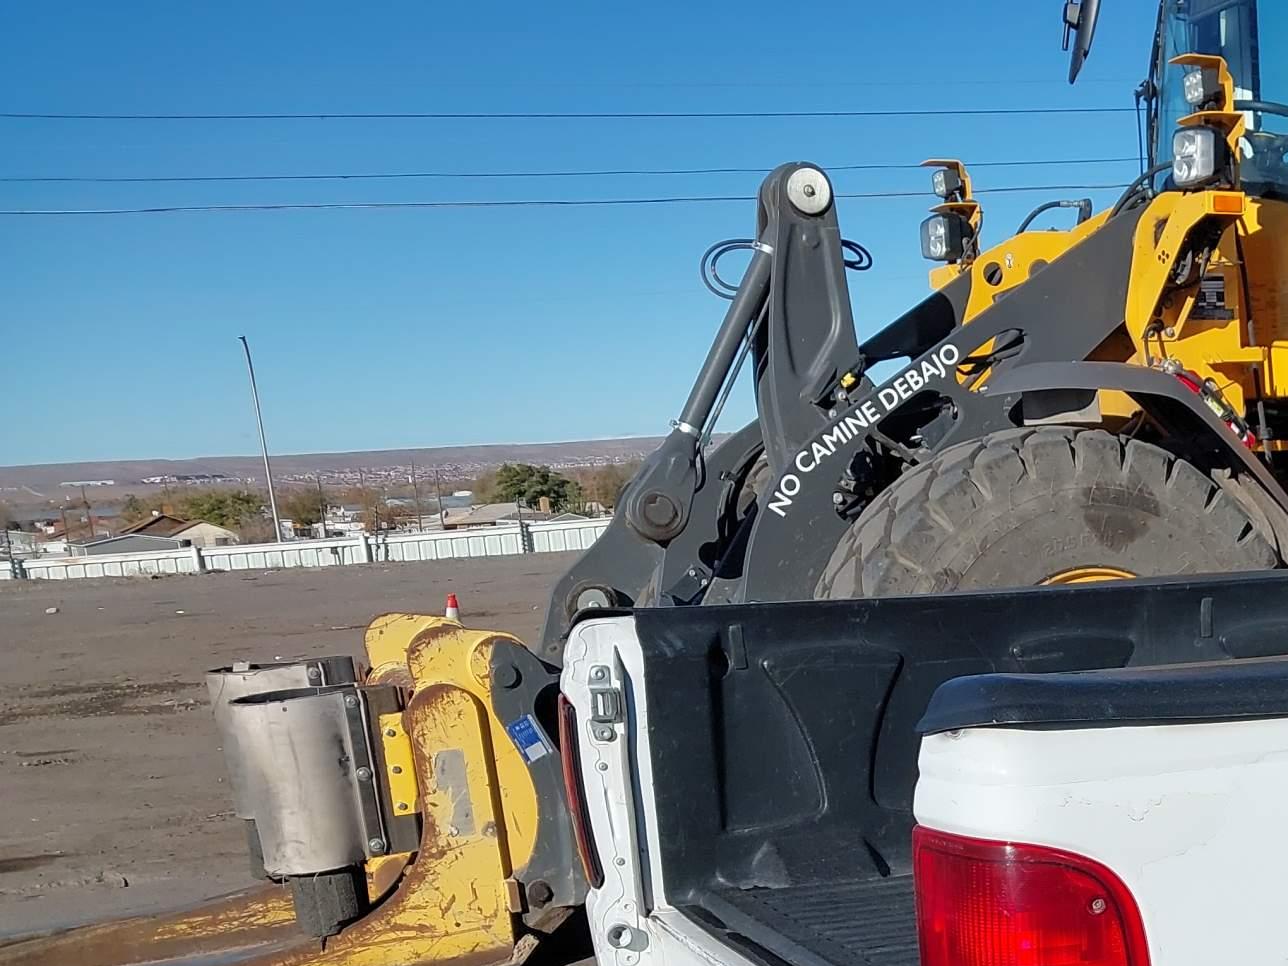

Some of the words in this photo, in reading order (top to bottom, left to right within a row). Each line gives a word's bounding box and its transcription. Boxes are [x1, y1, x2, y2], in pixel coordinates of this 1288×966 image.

[767, 474, 800, 518] NO
[795, 400, 881, 473] CAMINE
[878, 344, 959, 411] DEBAJO
